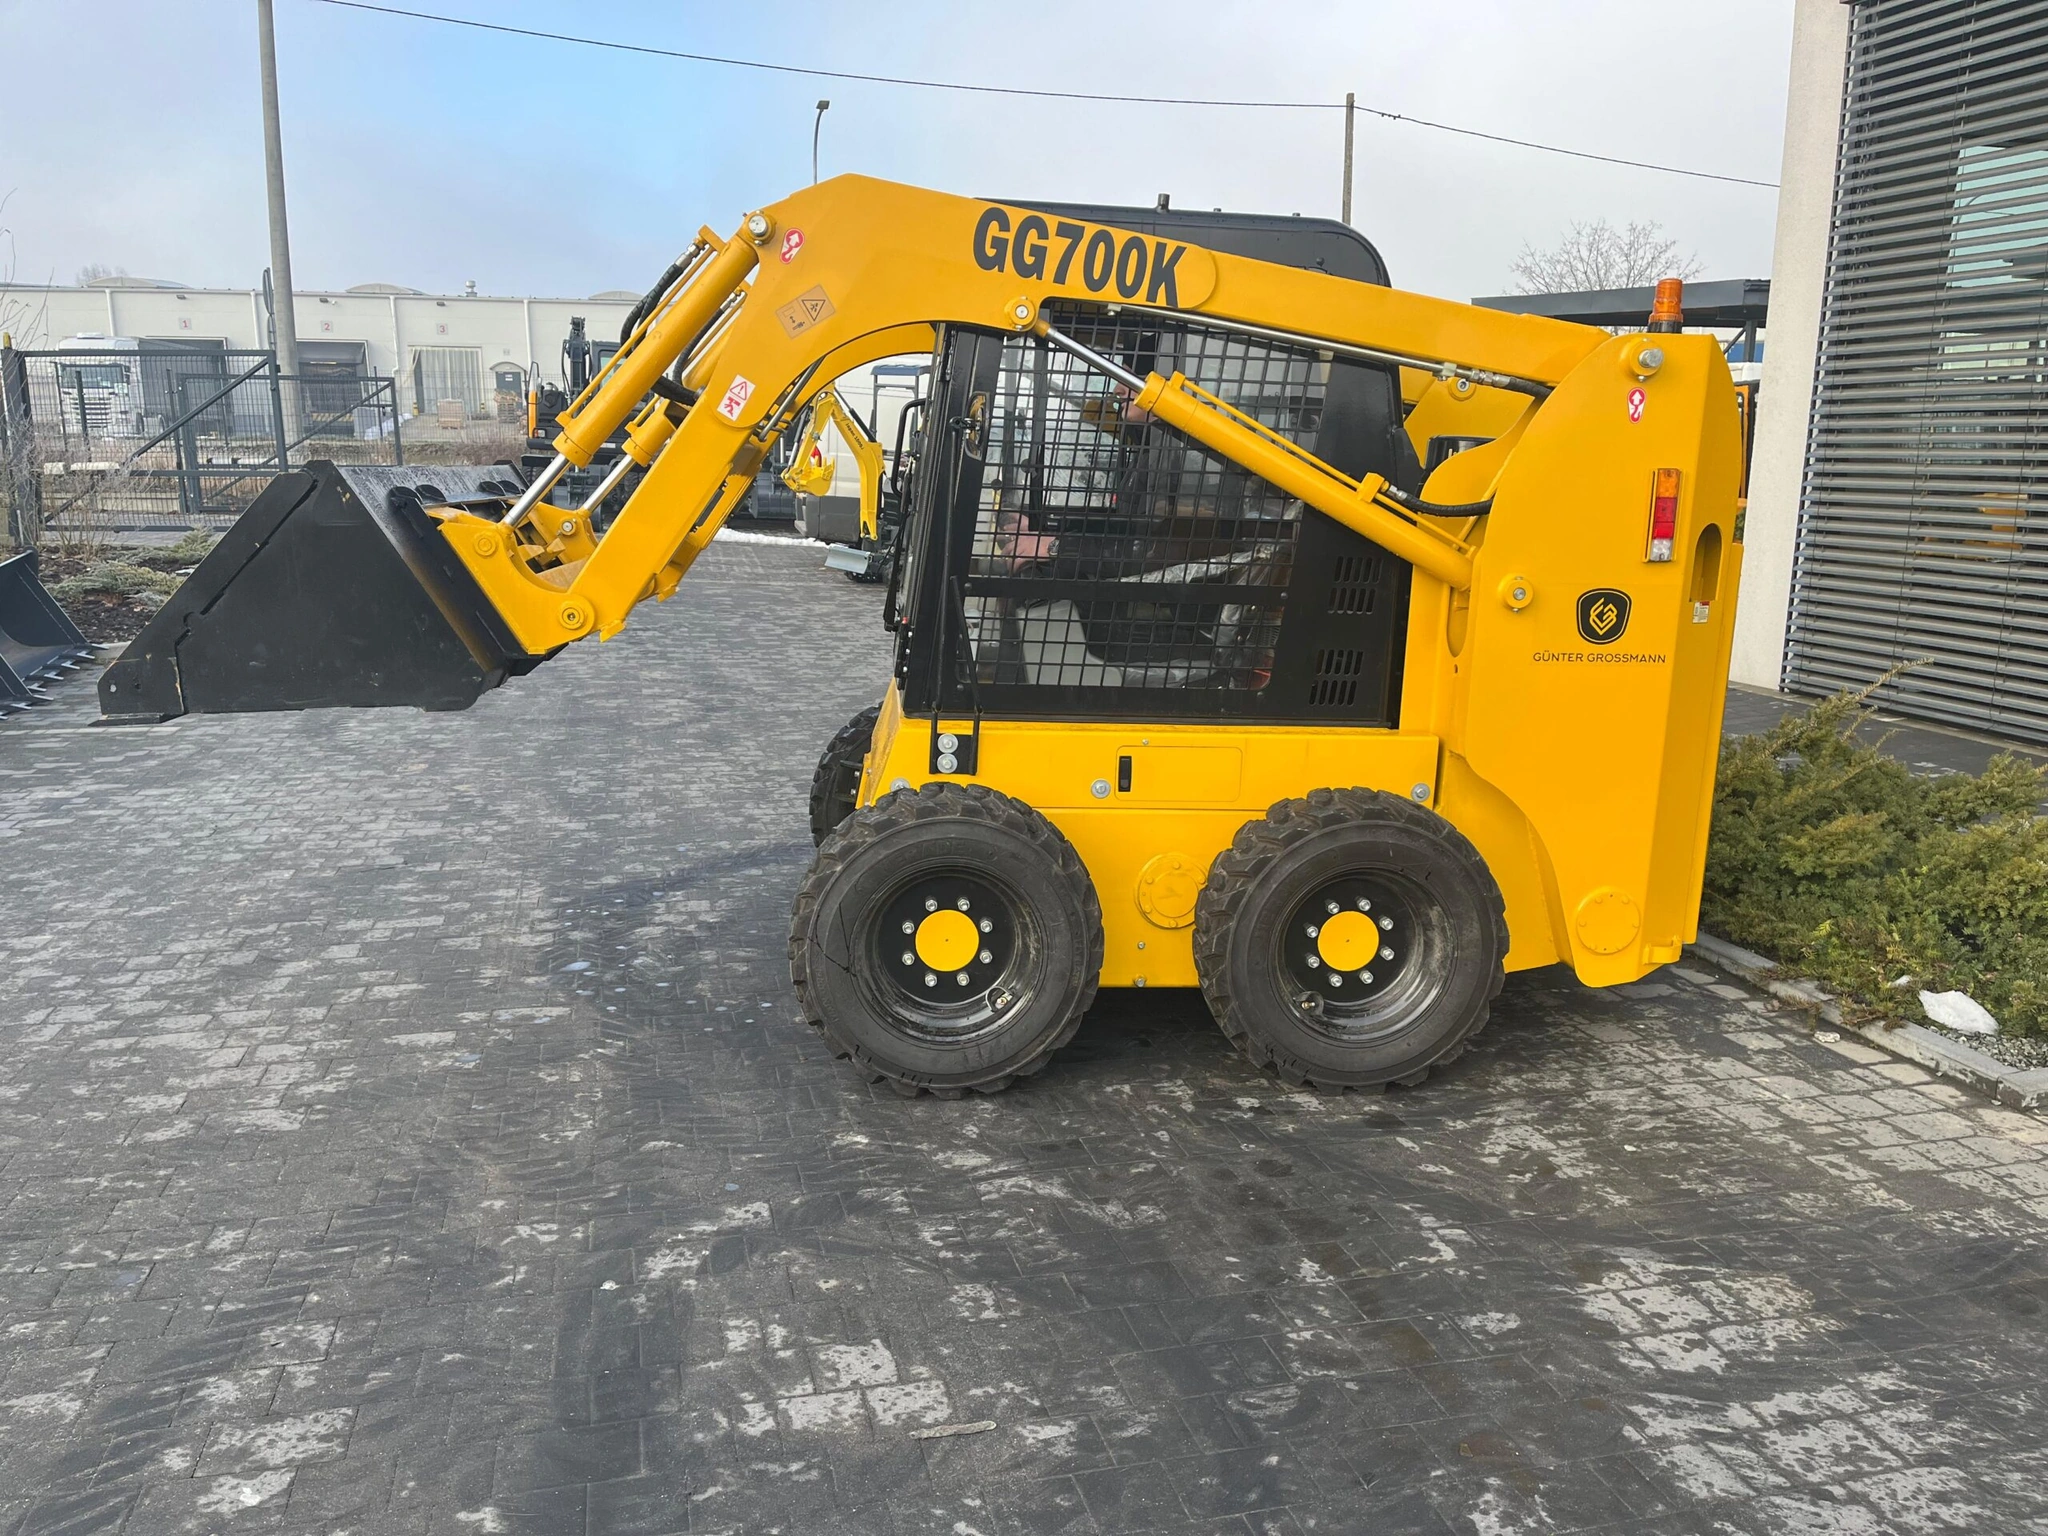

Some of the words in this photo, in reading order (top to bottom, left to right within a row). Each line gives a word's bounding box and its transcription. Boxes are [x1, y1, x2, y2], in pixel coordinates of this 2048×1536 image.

[973, 207, 1187, 308] GG700K
[1533, 650, 1584, 662] GÜNTER
[1587, 653, 1666, 663] GROSSMANN
